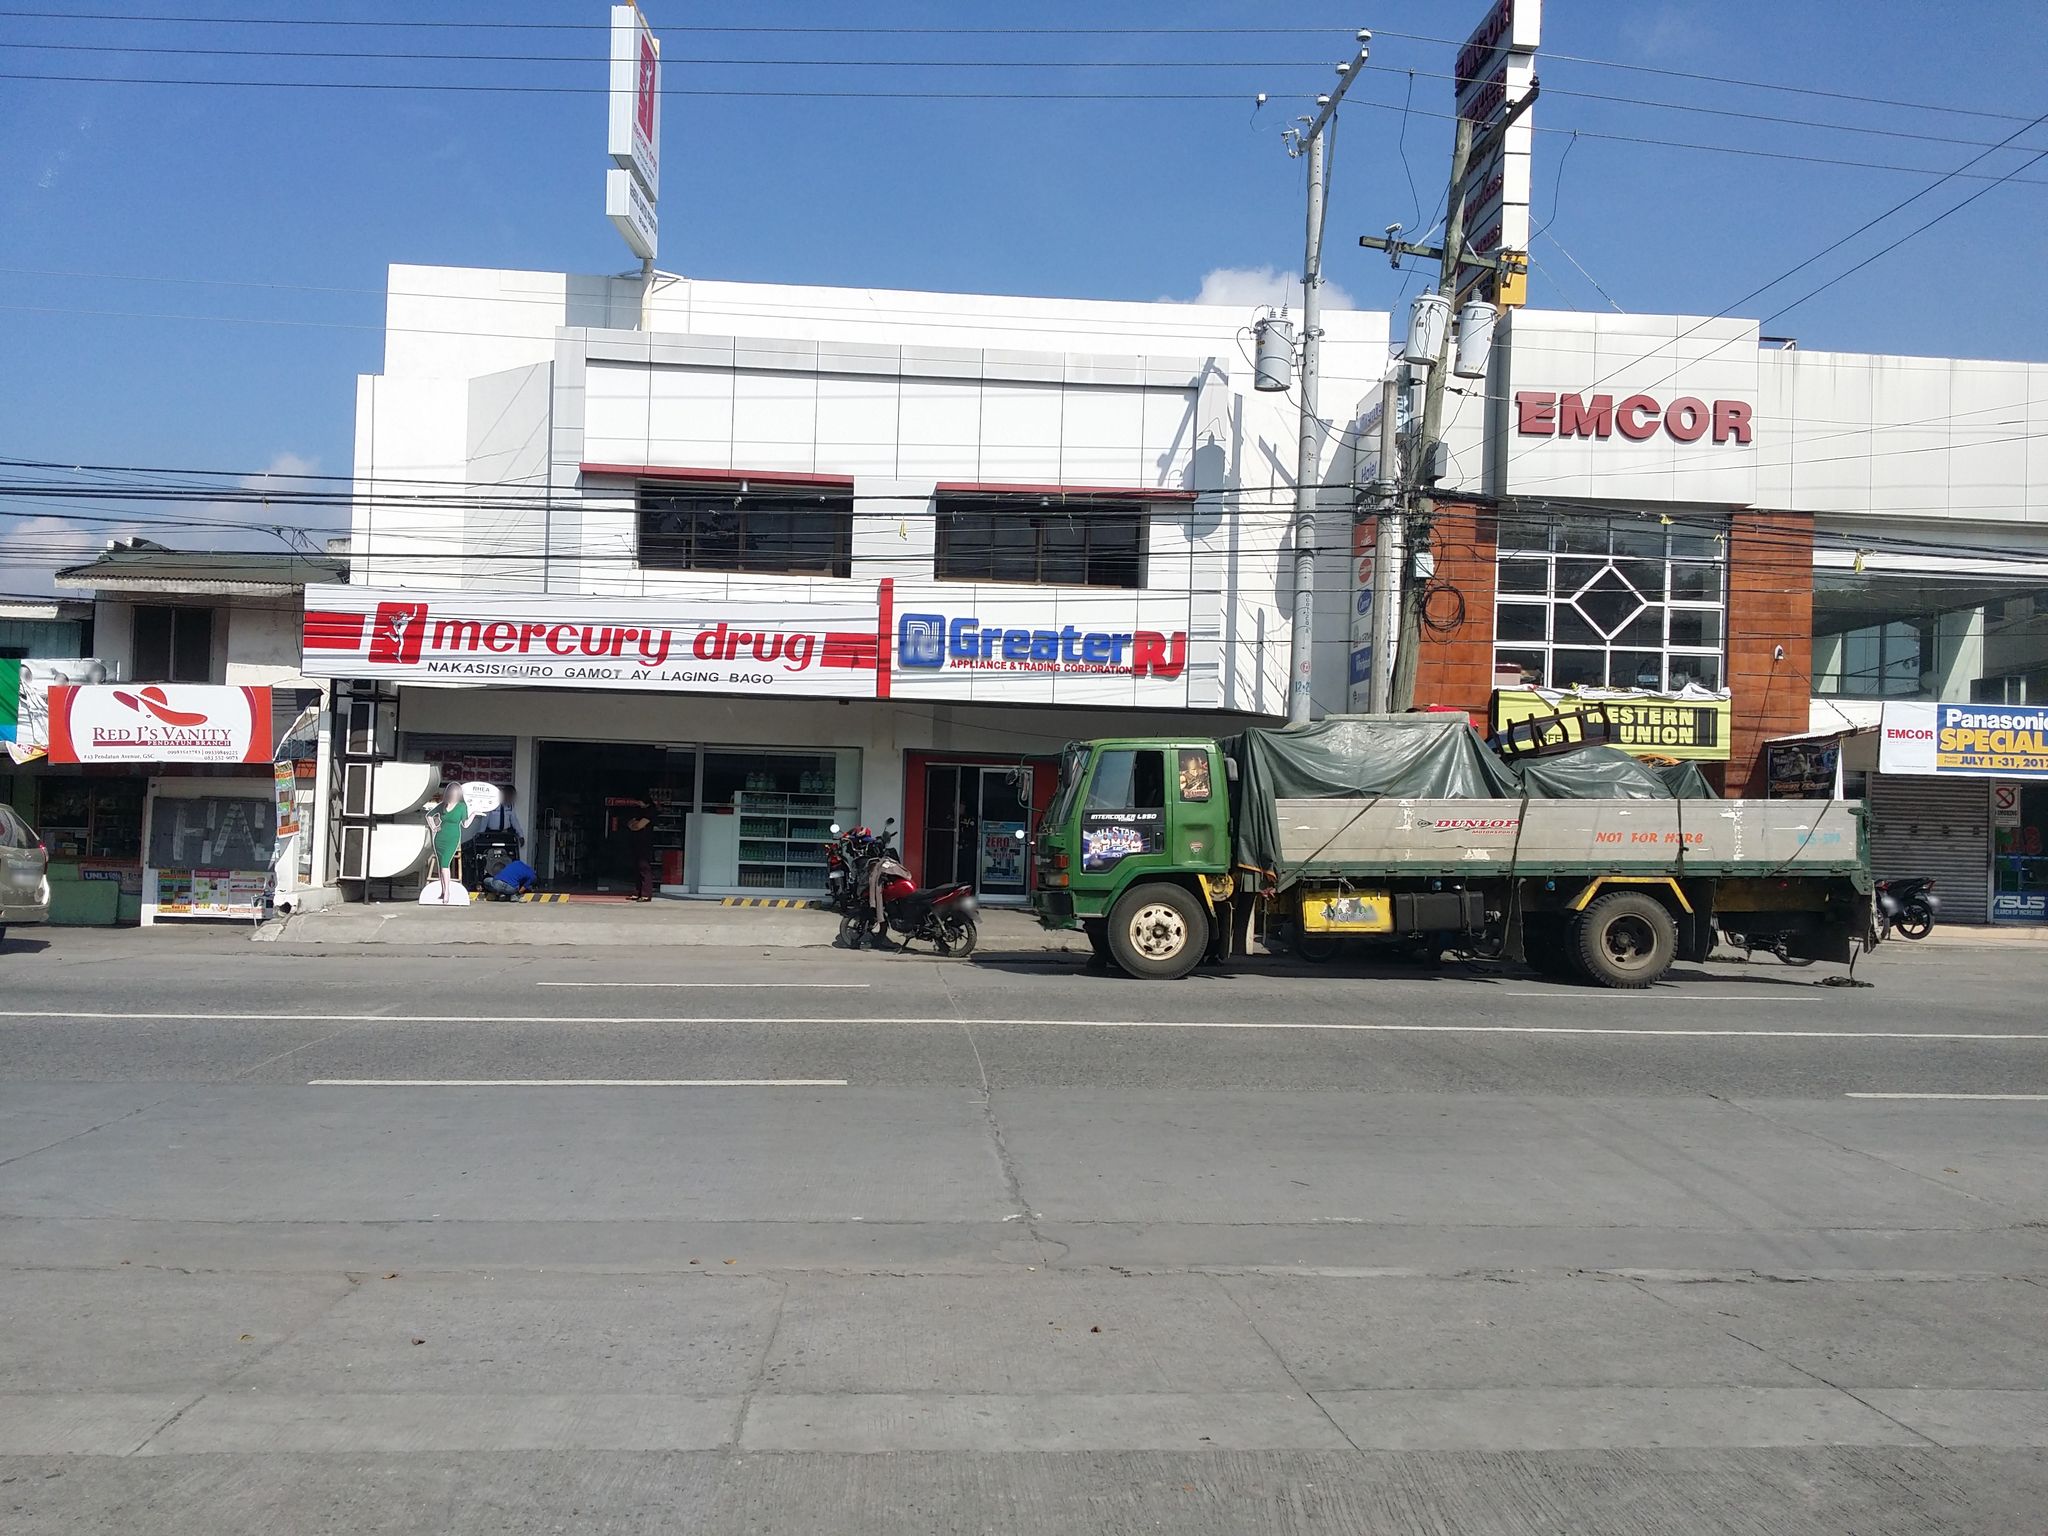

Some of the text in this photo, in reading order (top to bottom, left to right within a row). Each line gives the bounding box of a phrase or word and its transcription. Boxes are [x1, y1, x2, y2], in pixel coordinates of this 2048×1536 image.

[1515, 391, 1752, 443] EMCOR
[431, 620, 816, 672] mercury drug
[427, 662, 774, 684] NAKASISIGURO GAMOT AY LAGING BAGO
[950, 659, 1007, 670] APPLIANCE
[1018, 662, 1061, 672] TRADING
[1064, 664, 1132, 674] CORPORATION
[1586, 706, 1694, 726] WESTERN
[1620, 725, 1694, 745] UNION
[1887, 729, 1933, 740] EMCOR
[1940, 728, 2048, 754] SPECIAL
[1960, 756, 1984, 765] JULY
[1988, 757, 1993, 766] 1
[2023, 759, 2048, 767] 201
[1434, 818, 1520, 829] DUNLOP
[1596, 831, 1623, 843] NOT
[1631, 832, 1658, 843] FOR
[1993, 895, 2046, 909] ASUS
